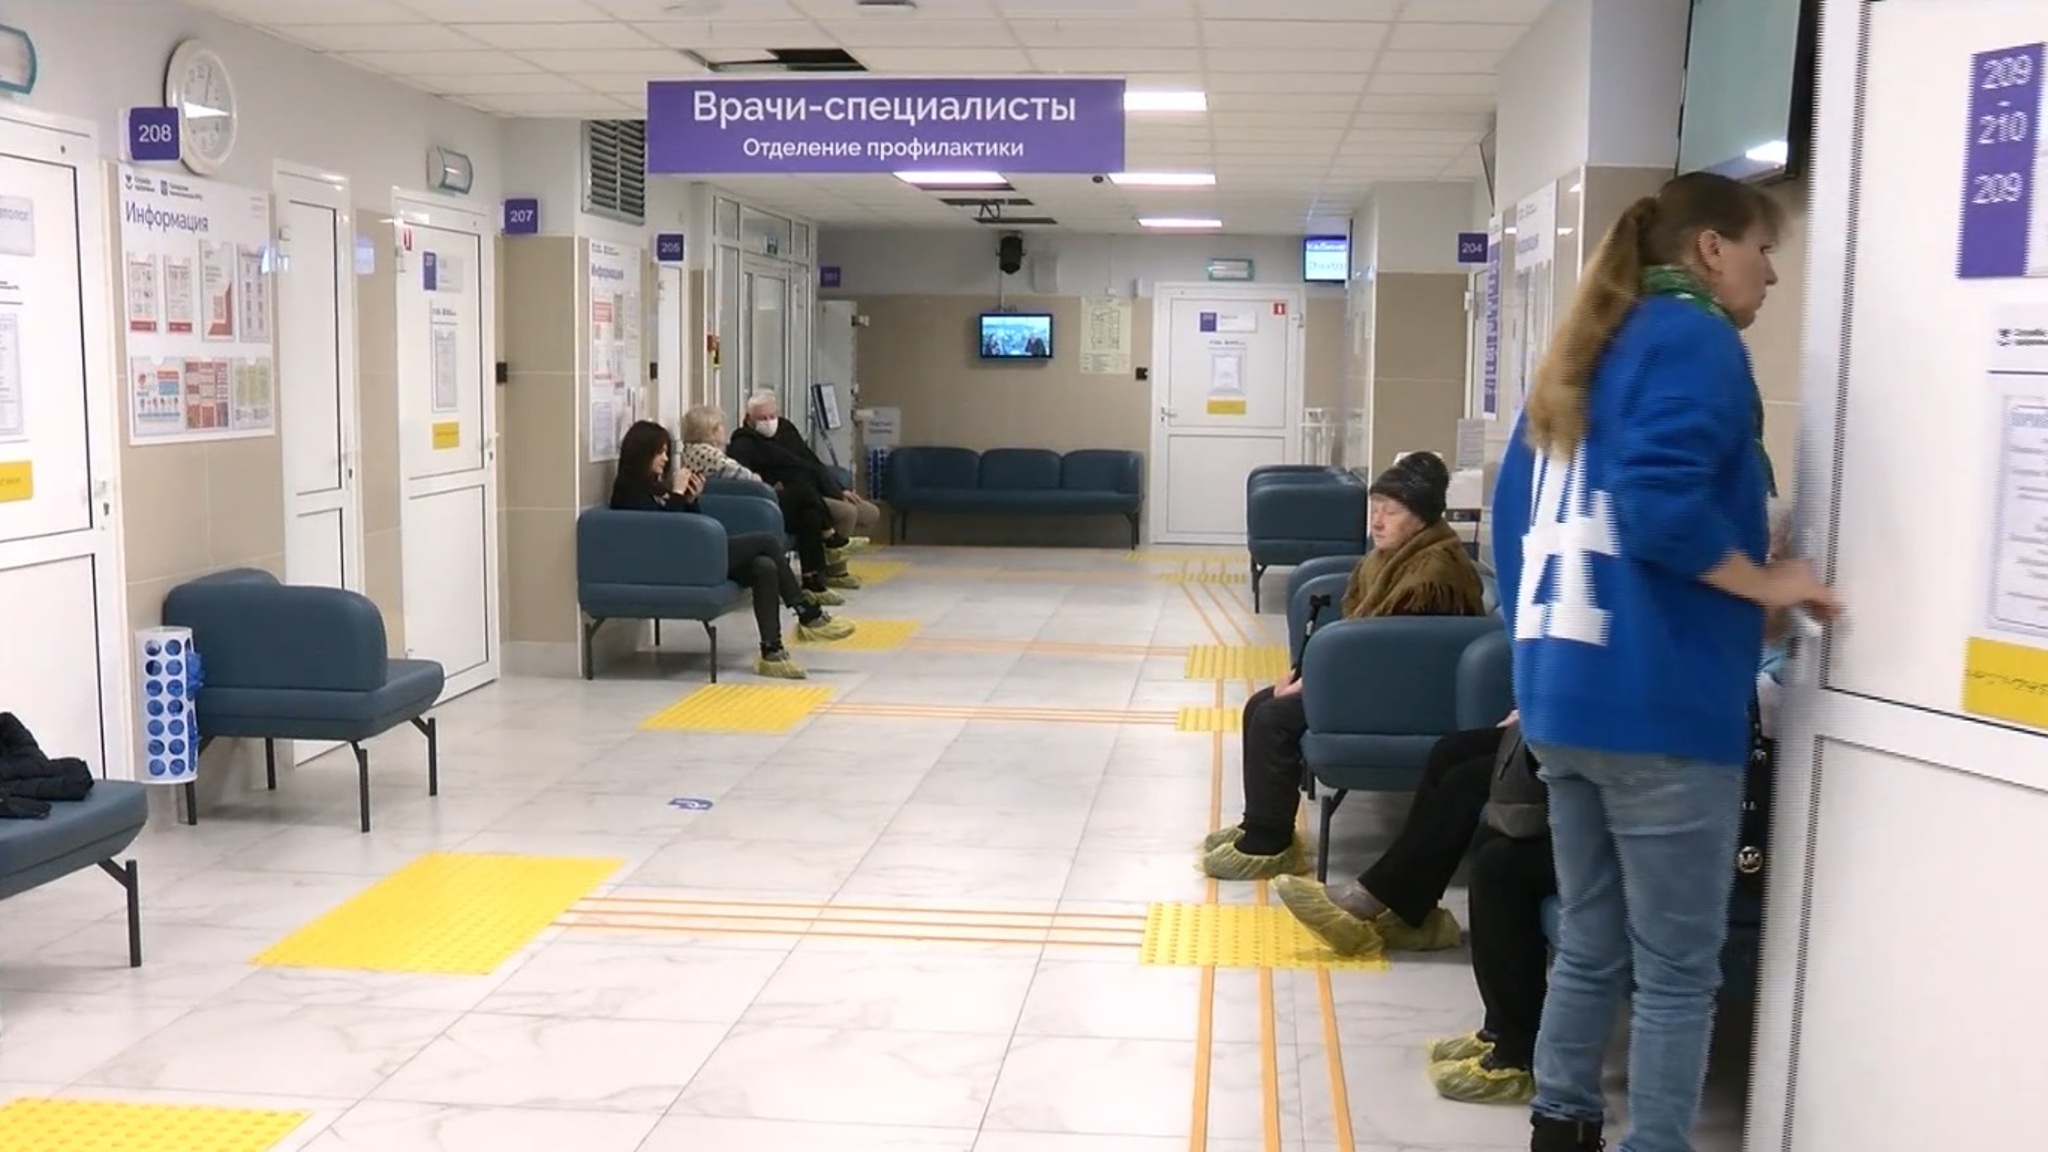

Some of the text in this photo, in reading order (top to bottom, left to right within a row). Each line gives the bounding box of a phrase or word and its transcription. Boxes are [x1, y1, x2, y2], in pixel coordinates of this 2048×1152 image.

[1981, 54, 2033, 89] 209
[693, 90, 1076, 129] Врачи-специалисты
[138, 124, 172, 143] 208
[1977, 110, 2028, 144] 210
[743, 138, 1024, 160] Отделение профилактики
[1972, 172, 2023, 205] 209
[125, 200, 209, 234] Информация
[510, 209, 534, 223] 207
[1461, 242, 1484, 254] 204
